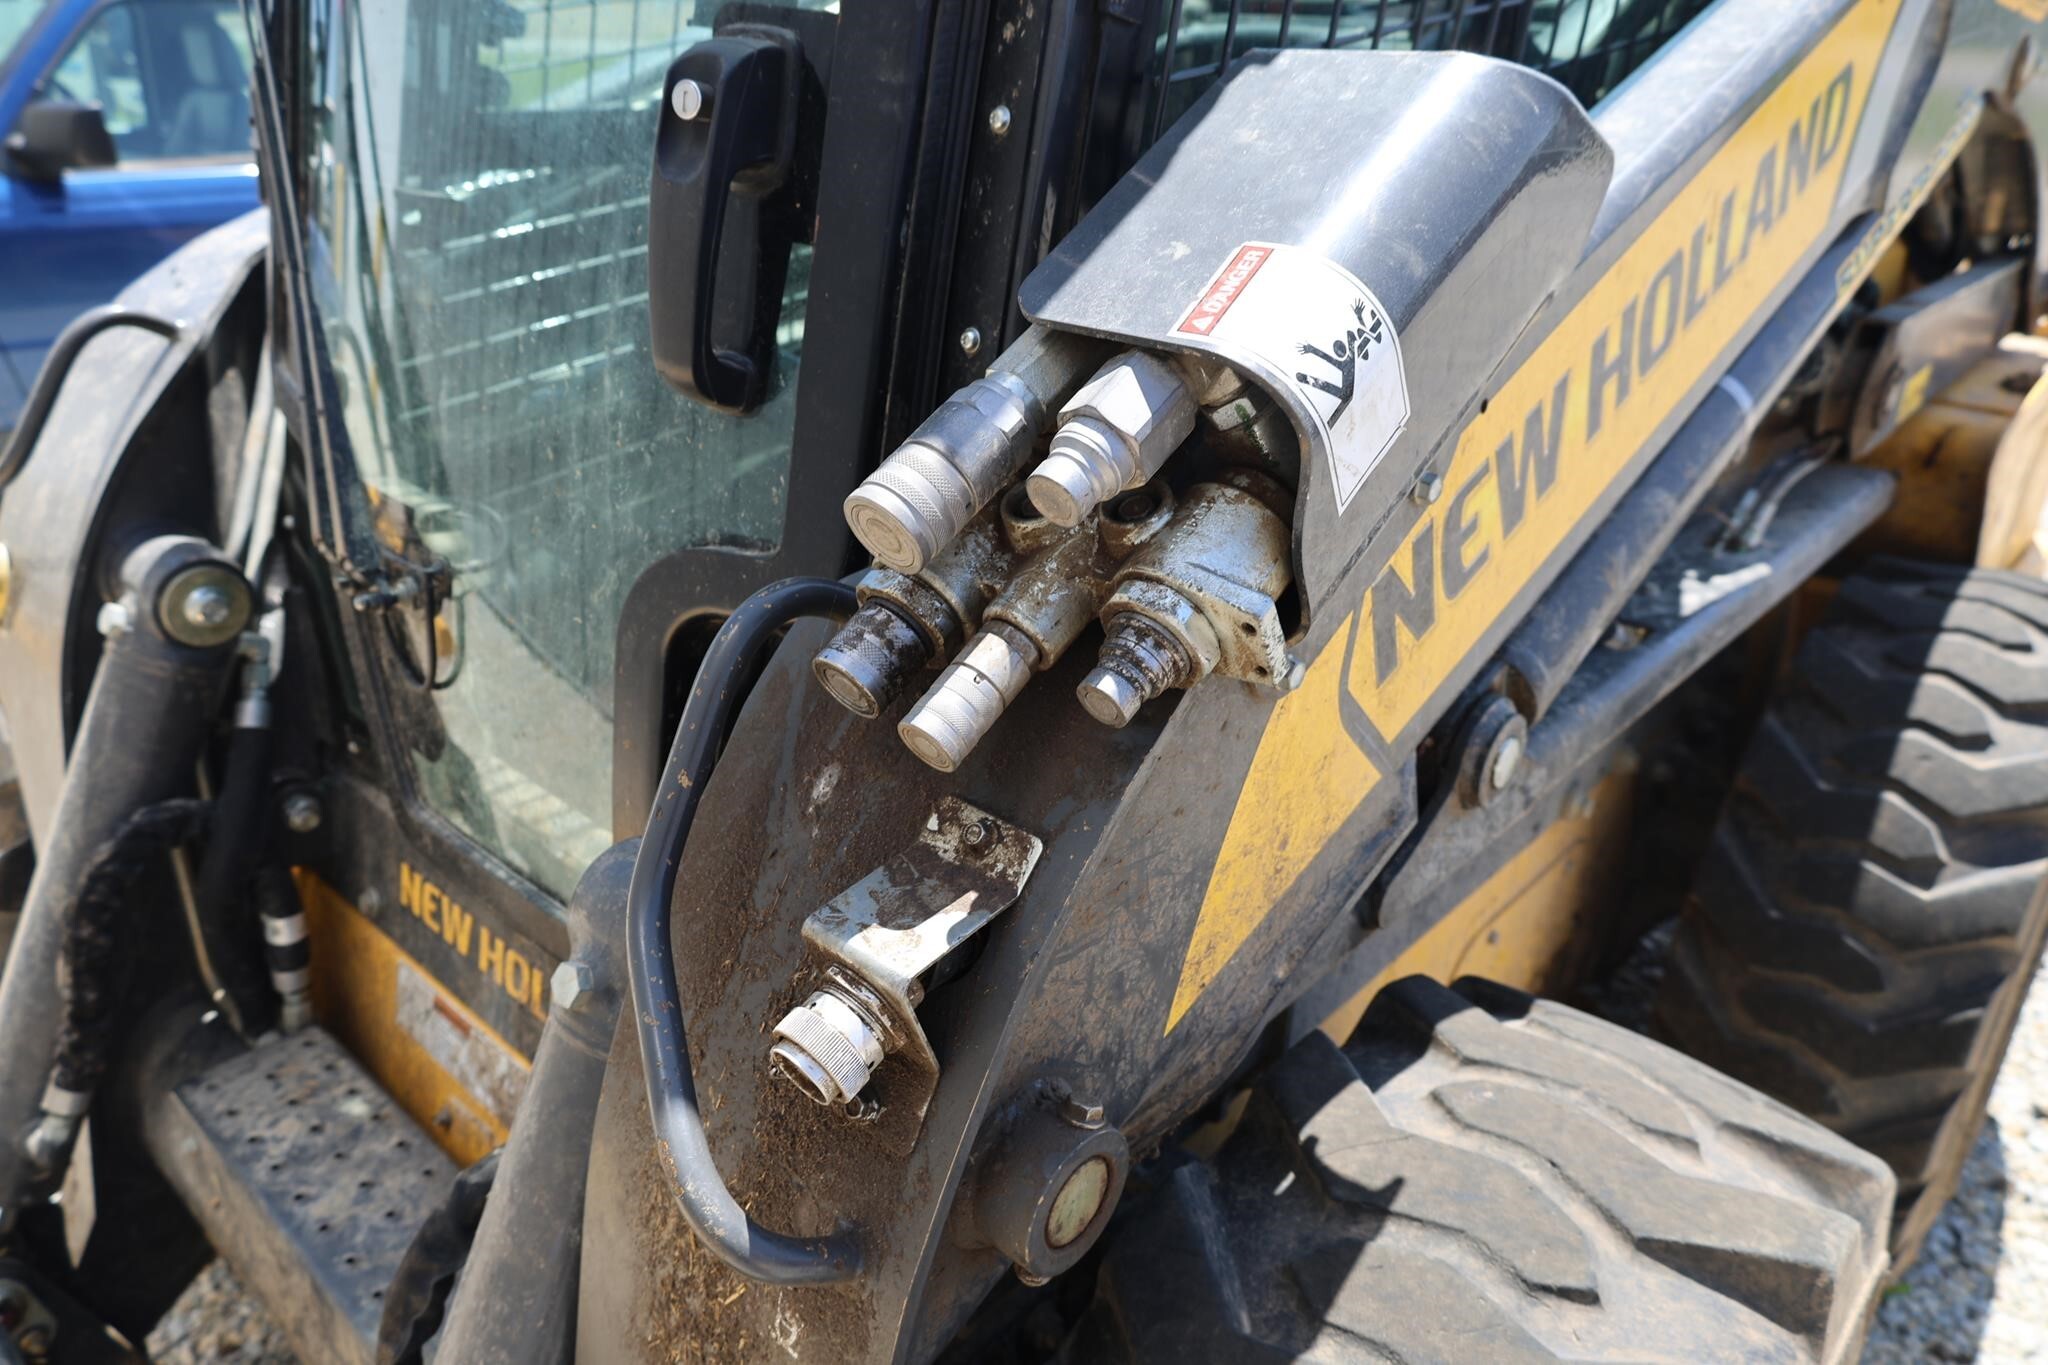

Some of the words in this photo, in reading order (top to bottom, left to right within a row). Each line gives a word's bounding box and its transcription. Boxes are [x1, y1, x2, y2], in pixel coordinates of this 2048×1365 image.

[1202, 250, 1265, 313] DANGER
[1364, 371, 1570, 689] NEW
[1586, 62, 1854, 445] HOLLAND
[400, 861, 474, 956] NEW
